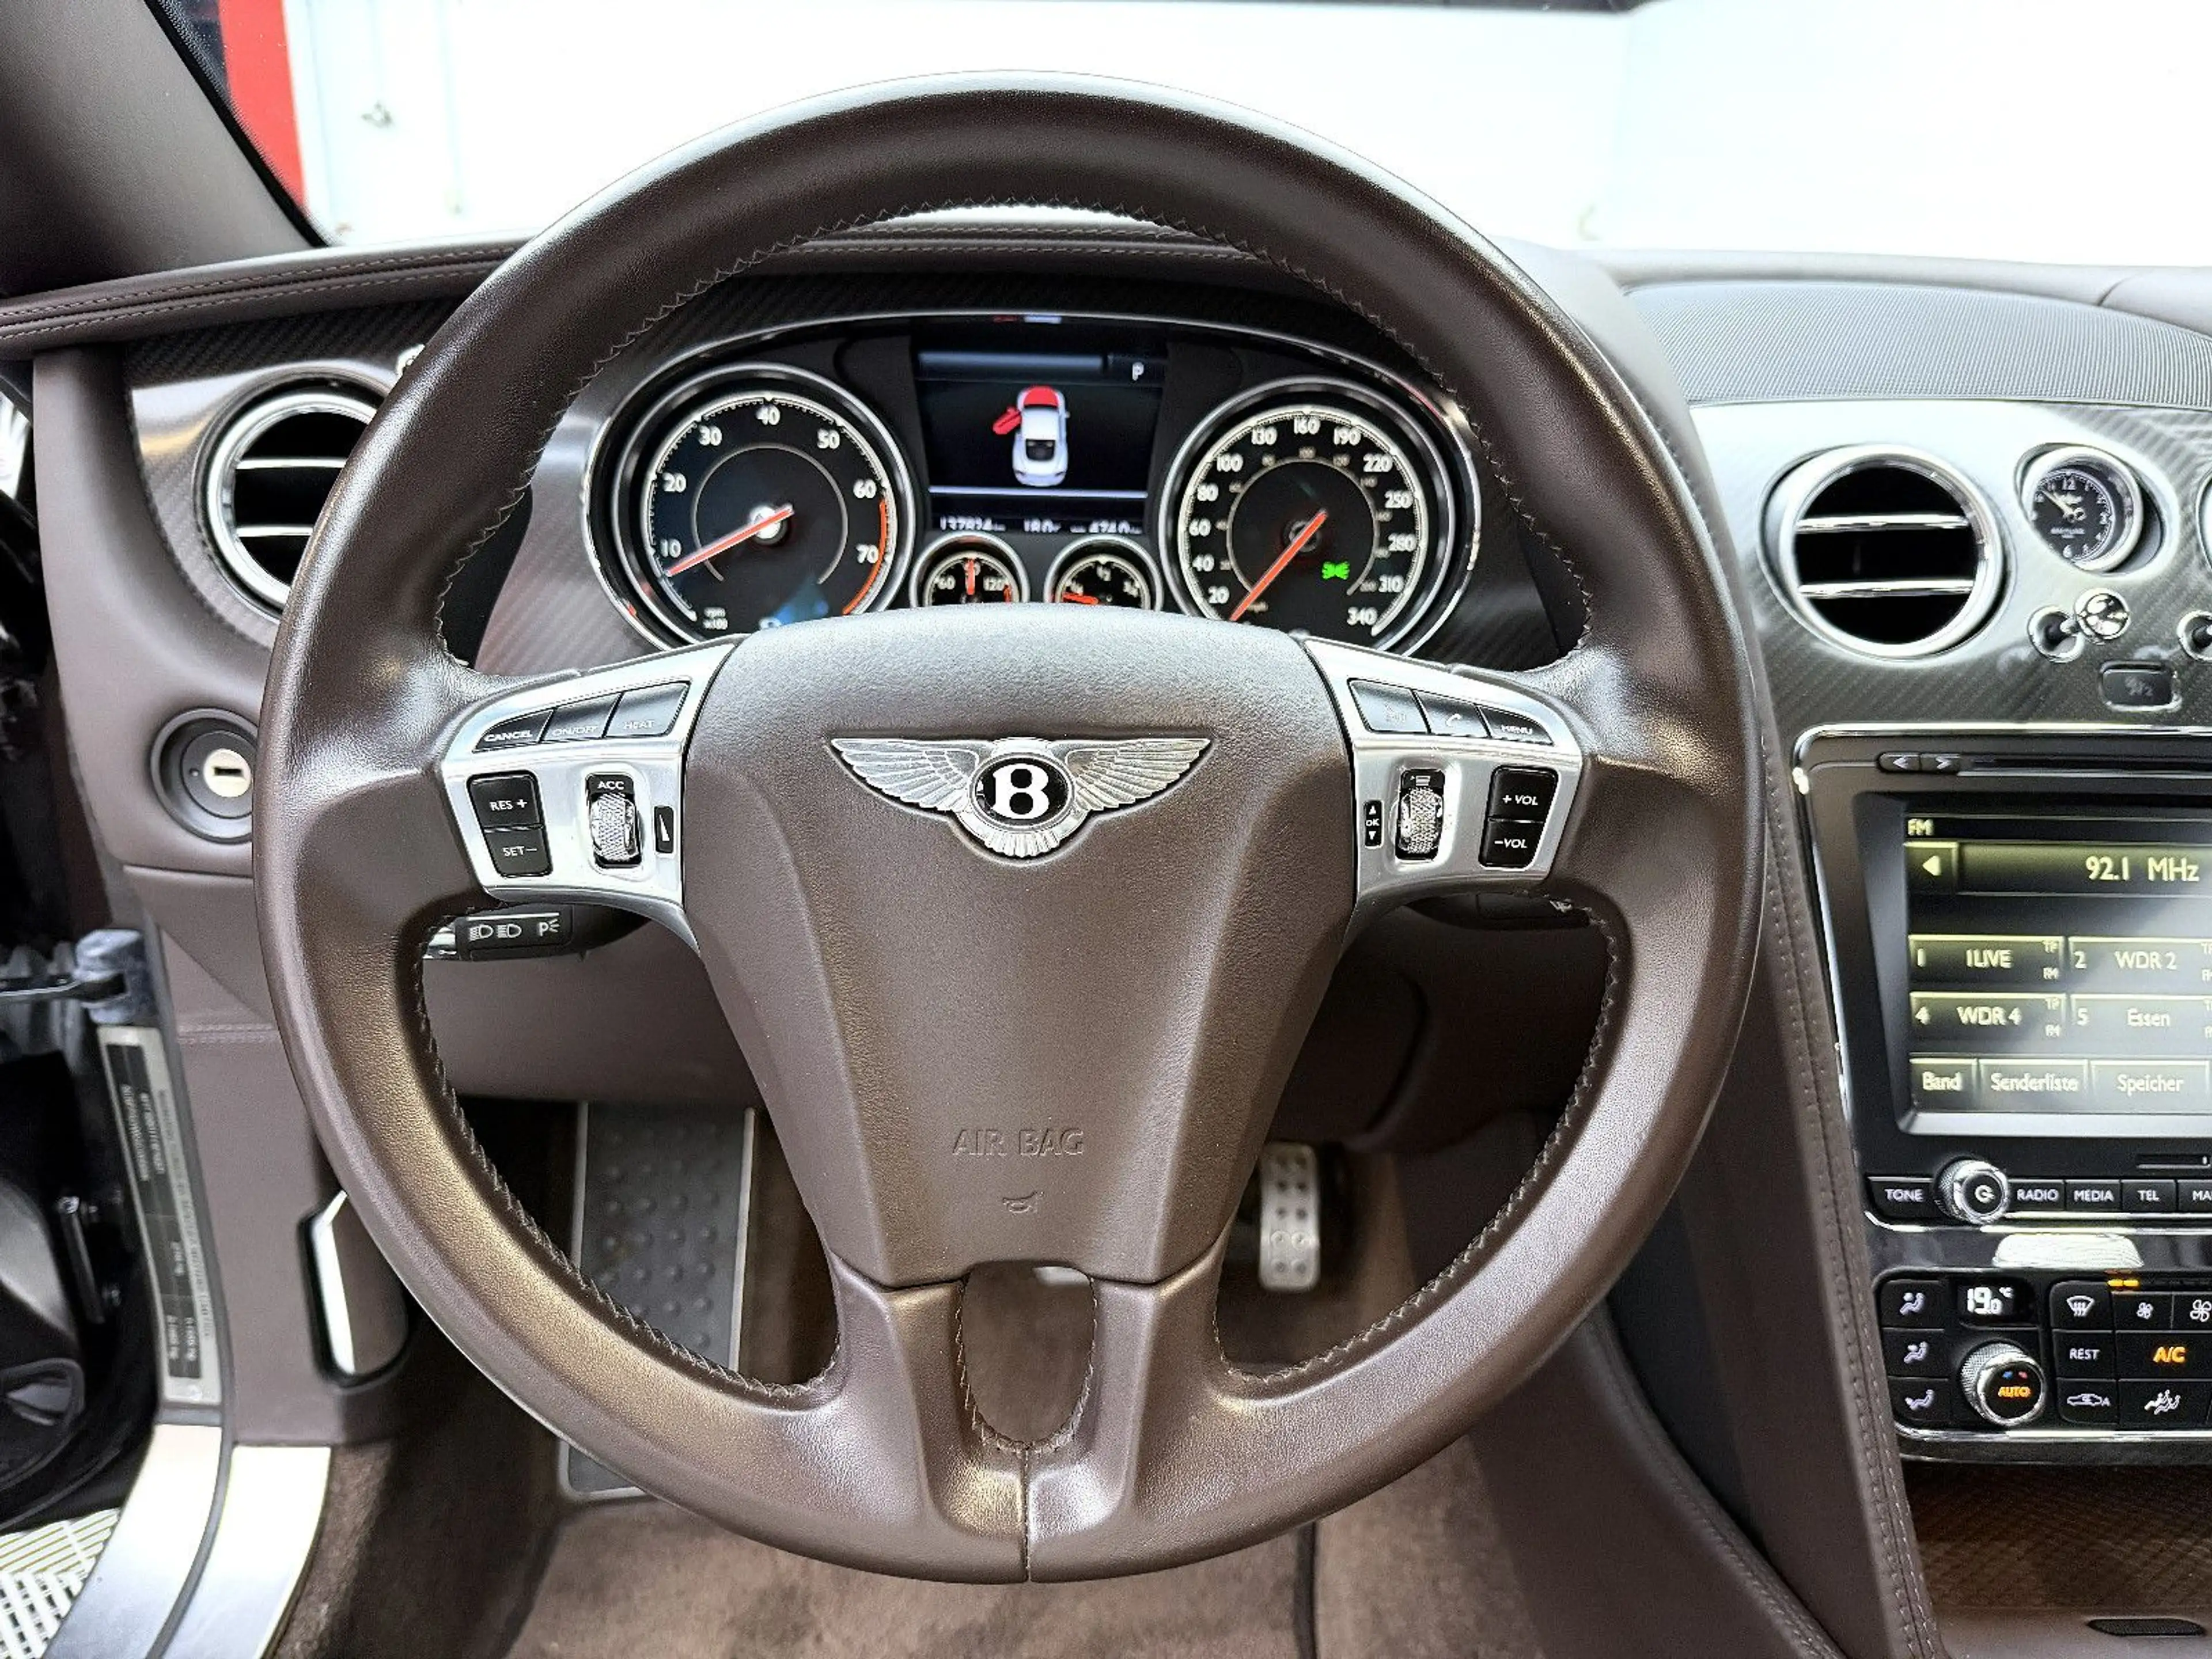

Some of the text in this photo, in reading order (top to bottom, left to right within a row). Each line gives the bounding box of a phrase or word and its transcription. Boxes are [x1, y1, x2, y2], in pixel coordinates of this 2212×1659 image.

[1132, 362, 1144, 381] P
[757, 406, 781, 425] 40
[1293, 418, 1320, 434] 160
[699, 426, 722, 445] 30
[818, 430, 839, 449] 50
[1252, 428, 1277, 445] 130
[1334, 428, 1361, 445] 190
[1217, 454, 1243, 472] 100
[1363, 454, 1392, 472] 220
[663, 473, 686, 492] 20
[854, 480, 876, 498] 60
[1198, 484, 1218, 501] 80
[1385, 491, 1412, 508] 250
[1189, 519, 1210, 536] 60
[661, 540, 681, 557] 10
[857, 544, 878, 563] 70
[1193, 555, 1214, 571] 40
[983, 577, 1004, 591] 120
[1379, 576, 1403, 592] 310
[1209, 588, 1230, 604] 20
[1347, 607, 1377, 625] 340
[552, 725, 599, 737] ON/OFF
[623, 720, 654, 730] HEAT
[484, 730, 533, 743] CANCEL
[597, 780, 624, 790] ACC
[993, 762, 1048, 819] B
[490, 800, 512, 811] RES
[1515, 794, 1539, 806] VOL
[1366, 819, 1380, 827] OK
[1908, 819, 1933, 835] FM
[2086, 856, 2200, 881] 92.1 MHz
[2074, 950, 2087, 969] 2
[2114, 950, 2177, 970] WDR 2
[1915, 1007, 1930, 1025] 4
[1957, 1007, 2022, 1025] WDR 4
[2076, 1008, 2090, 1027] 5
[2127, 1009, 2171, 1027] Essen
[1922, 1071, 1963, 1091] Band
[1991, 1073, 2078, 1092] Senderliste
[2118, 1074, 2184, 1097] Speicher
[952, 1128, 1084, 1156] AIR BAG
[1884, 1188, 1923, 1202] TONE
[2017, 1190, 2059, 1201] RADIO
[2074, 1190, 2114, 1202] MEDIA
[2137, 1190, 2160, 1202] TEL
[2192, 1190, 2212, 1201] MA
[2069, 1349, 2100, 1360] REST
[2153, 1347, 2187, 1363] A/C
[1998, 1386, 2031, 1398] AUTO
